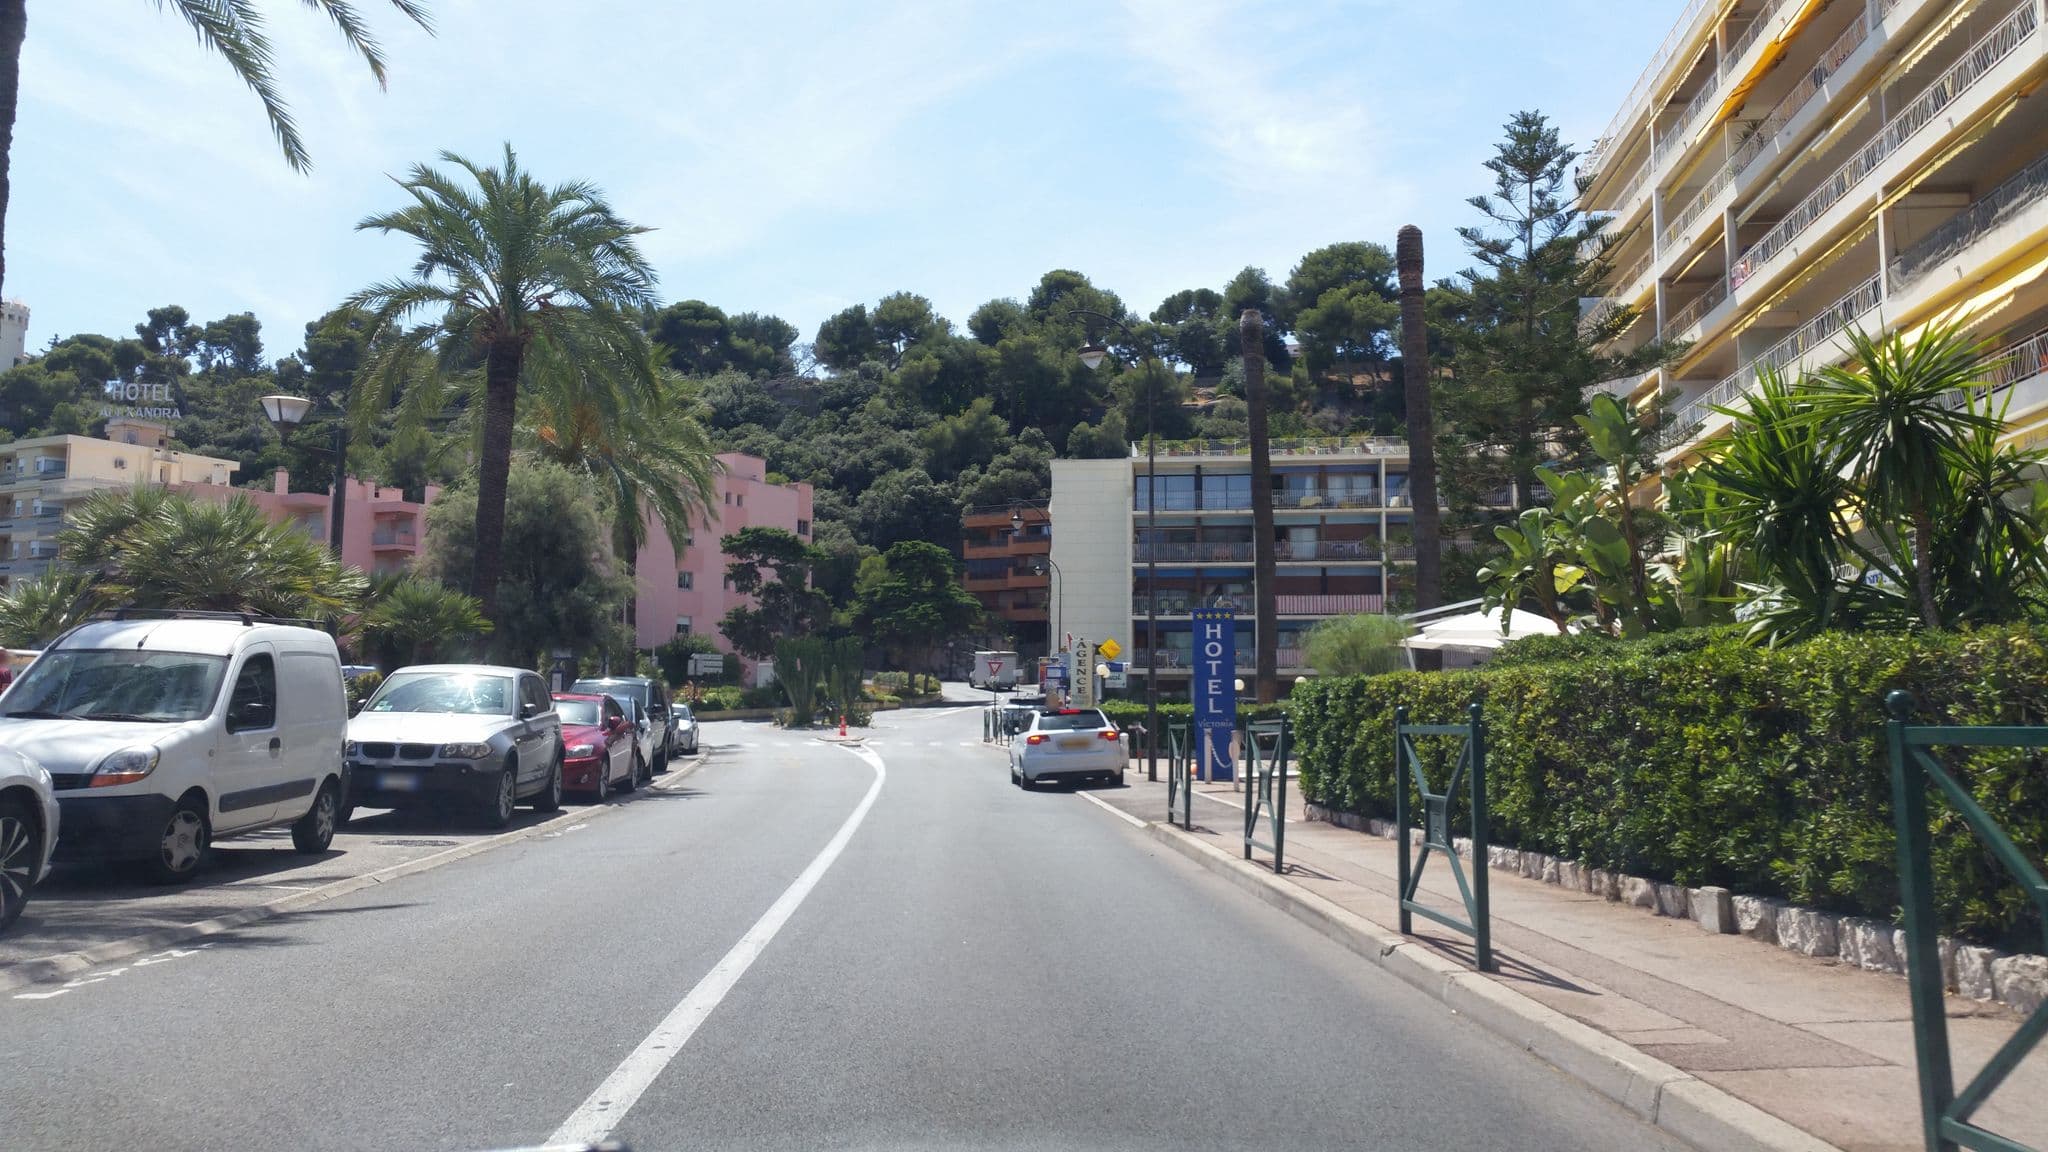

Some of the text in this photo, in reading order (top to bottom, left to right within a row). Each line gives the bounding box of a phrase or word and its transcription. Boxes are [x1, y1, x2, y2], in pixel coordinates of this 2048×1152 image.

[112, 383, 174, 402] HOTEL
[1076, 641, 1087, 694] AGENCE
[1205, 623, 1222, 713] HOTEL
